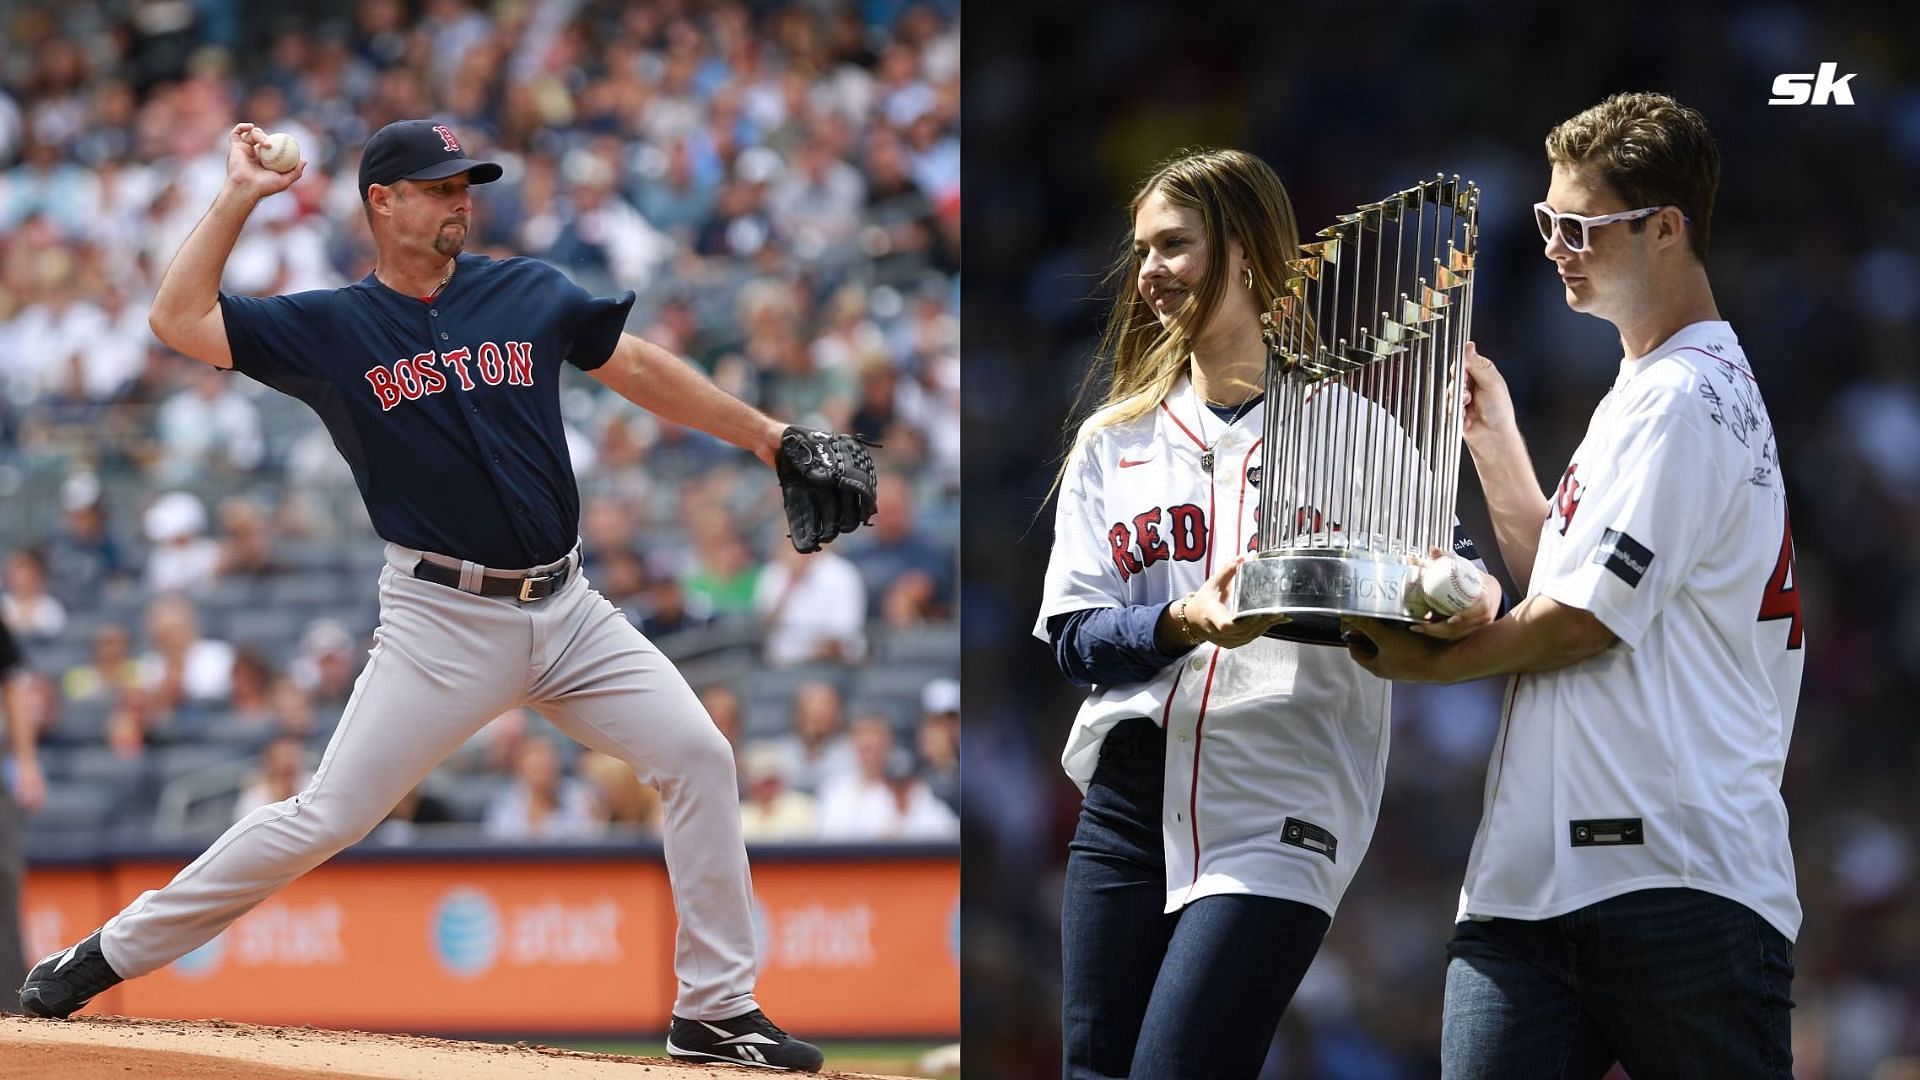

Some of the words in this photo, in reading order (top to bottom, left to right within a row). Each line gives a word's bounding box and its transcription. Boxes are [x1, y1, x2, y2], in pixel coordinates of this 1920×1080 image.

[432, 125, 460, 152] B
[365, 342, 534, 411] BOSTON
[1108, 503, 1208, 583] RED
